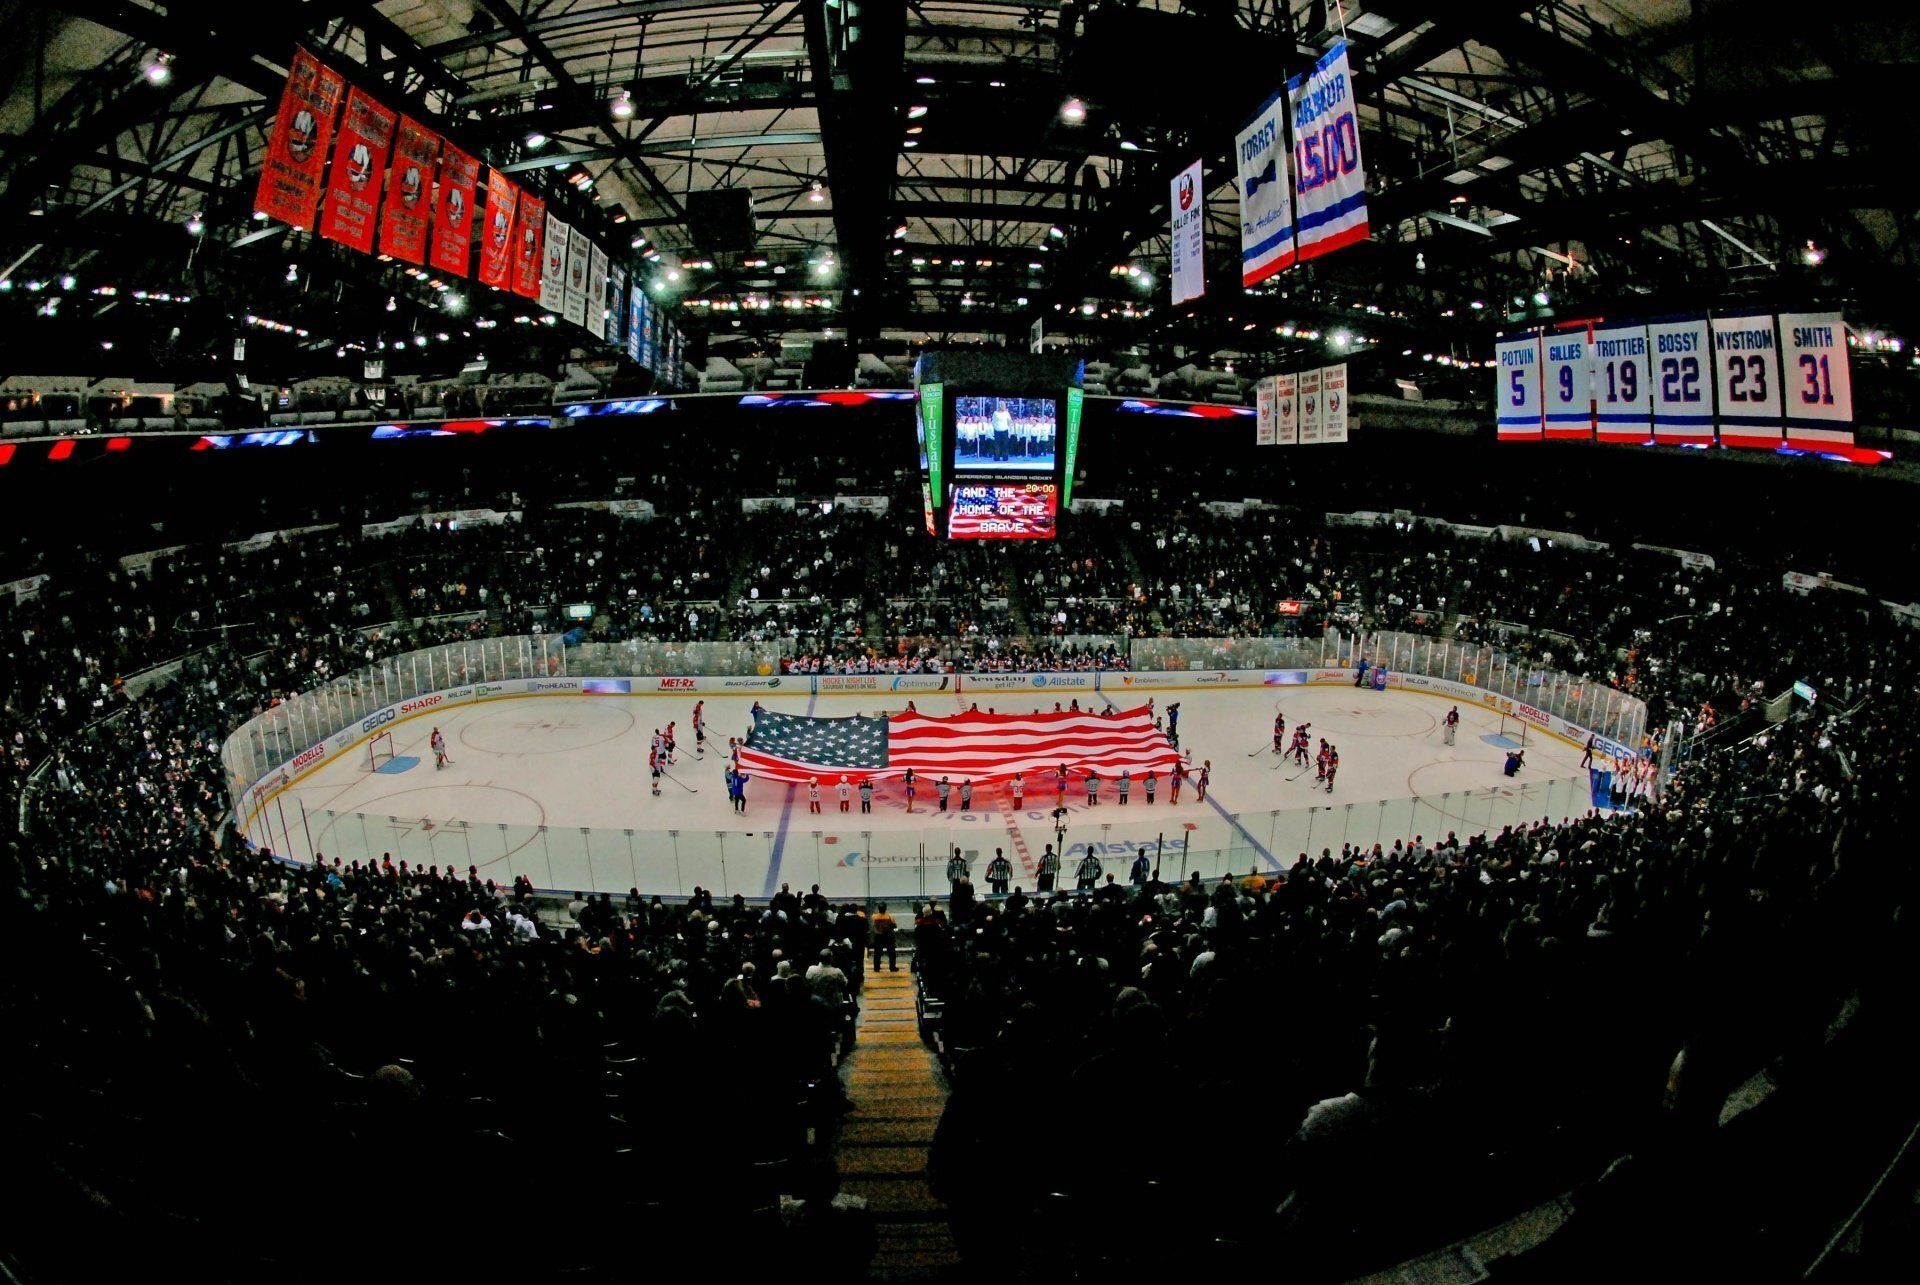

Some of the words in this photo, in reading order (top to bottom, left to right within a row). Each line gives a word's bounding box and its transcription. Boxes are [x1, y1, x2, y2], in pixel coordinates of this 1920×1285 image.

[1241, 117, 1276, 164] TORREY
[1294, 111, 1358, 194] 1500
[1596, 337, 1645, 357] TROTTIER
[1658, 332, 1698, 353] BOSSY
[1716, 329, 1773, 350] NYSTROM
[1793, 327, 1833, 348] SMITH
[1502, 348, 1534, 366] POTVIN
[1550, 344, 1581, 361] GILLIES
[1511, 370, 1526, 406] 5
[1559, 365, 1574, 402] 9
[1606, 360, 1638, 403] 19
[1661, 357, 1701, 402] 22
[1728, 355, 1767, 403] 23
[1799, 354, 1834, 405] 31
[927, 405, 939, 471] Tuscan
[962, 487, 986, 498] AND
[993, 487, 1016, 498] THE
[960, 504, 992, 515] HOME
[1000, 504, 1015, 515] OF
[1022, 504, 1045, 515] THE
[537, 682, 577, 690] ProHEALTH
[661, 678, 695, 688] MET-Rx
[900, 680, 940, 688] Optimum
[1049, 677, 1086, 686] Allstate
[1432, 684, 1476, 698] WINTHROP
[401, 695, 442, 714] SHARP
[1519, 703, 1550, 723] MODELL'S
[363, 709, 395, 733] GEICO
[293, 744, 324, 768] MODELL'S
[1594, 738, 1632, 762] GEICO
[810, 790, 818, 798] 12
[1064, 838, 1190, 857] Allstate
[861, 855, 951, 864] Optimum
